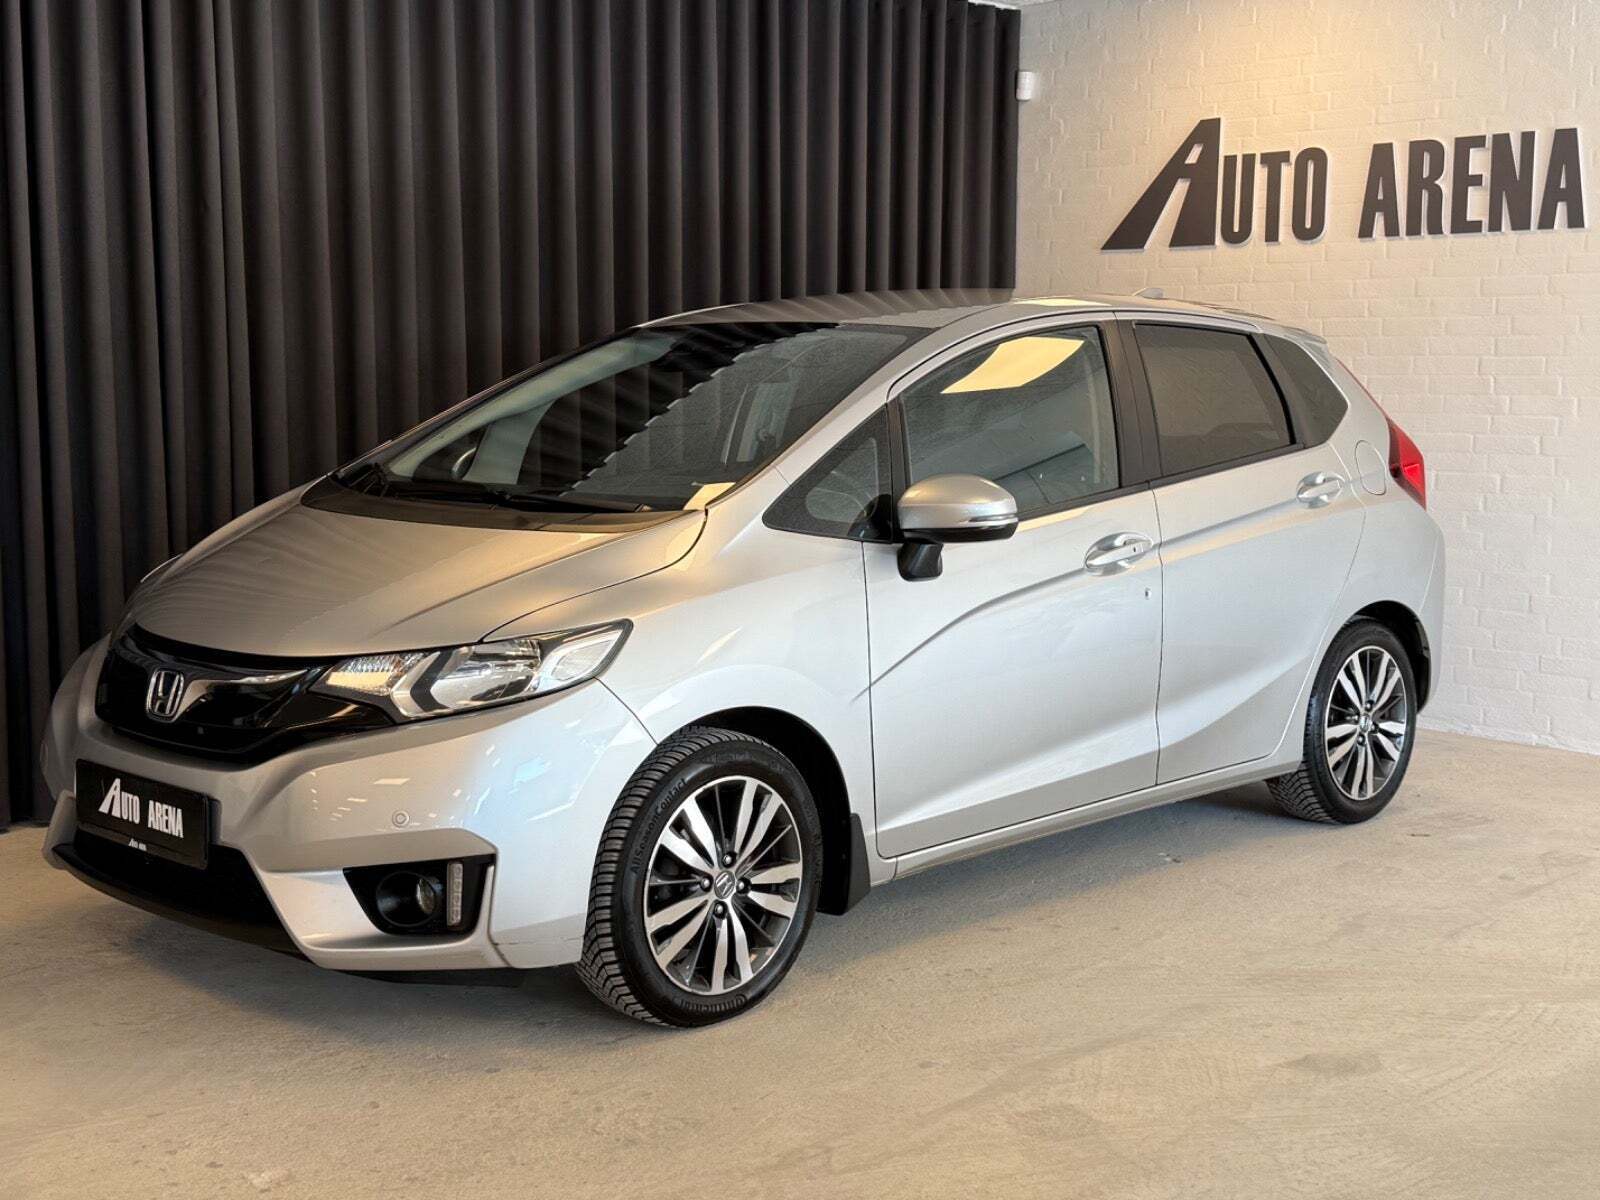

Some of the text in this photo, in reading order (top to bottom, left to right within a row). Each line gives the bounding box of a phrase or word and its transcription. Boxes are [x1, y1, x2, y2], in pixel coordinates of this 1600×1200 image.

[1101, 117, 1586, 250] AUTO ARENA
[98, 777, 184, 838] AUTO ARENA
